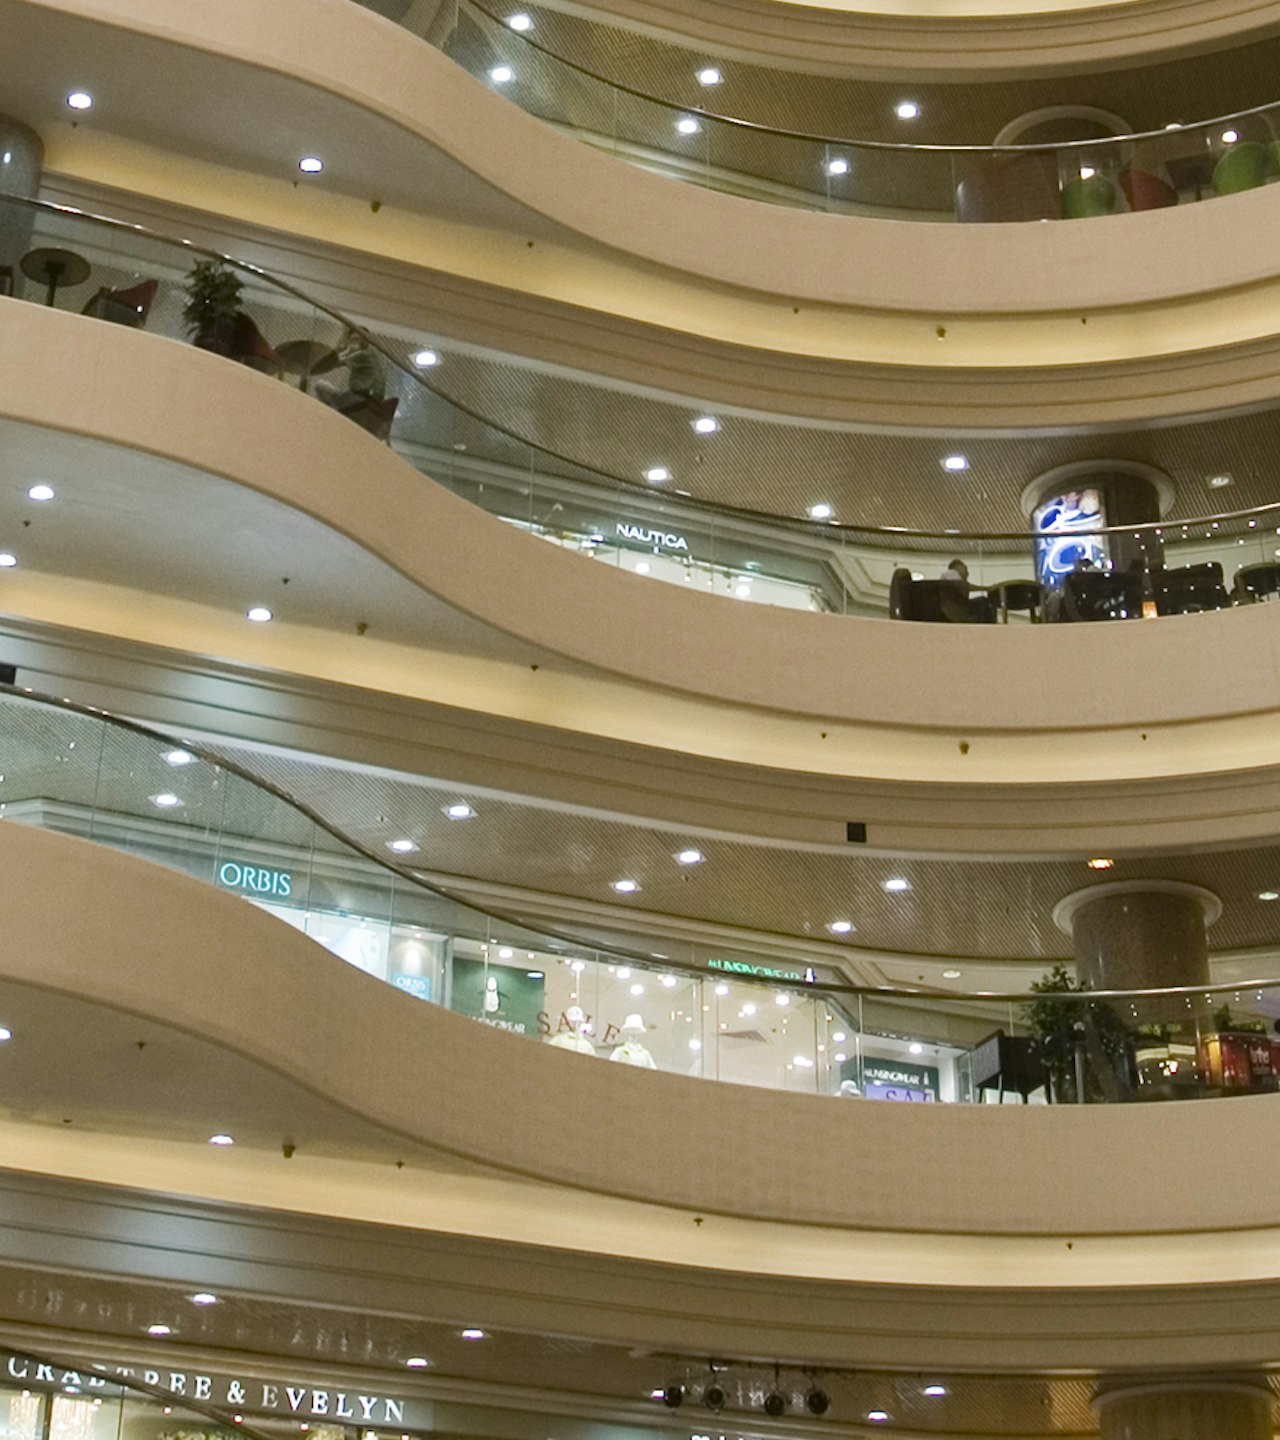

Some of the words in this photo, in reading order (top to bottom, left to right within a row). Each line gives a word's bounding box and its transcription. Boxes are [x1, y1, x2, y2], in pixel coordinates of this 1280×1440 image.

[616, 523, 688, 550] NAUTICA
[220, 863, 292, 896] ORBIS
[226, 1380, 247, 1405] &
[261, 1384, 406, 1423] EVELYN
